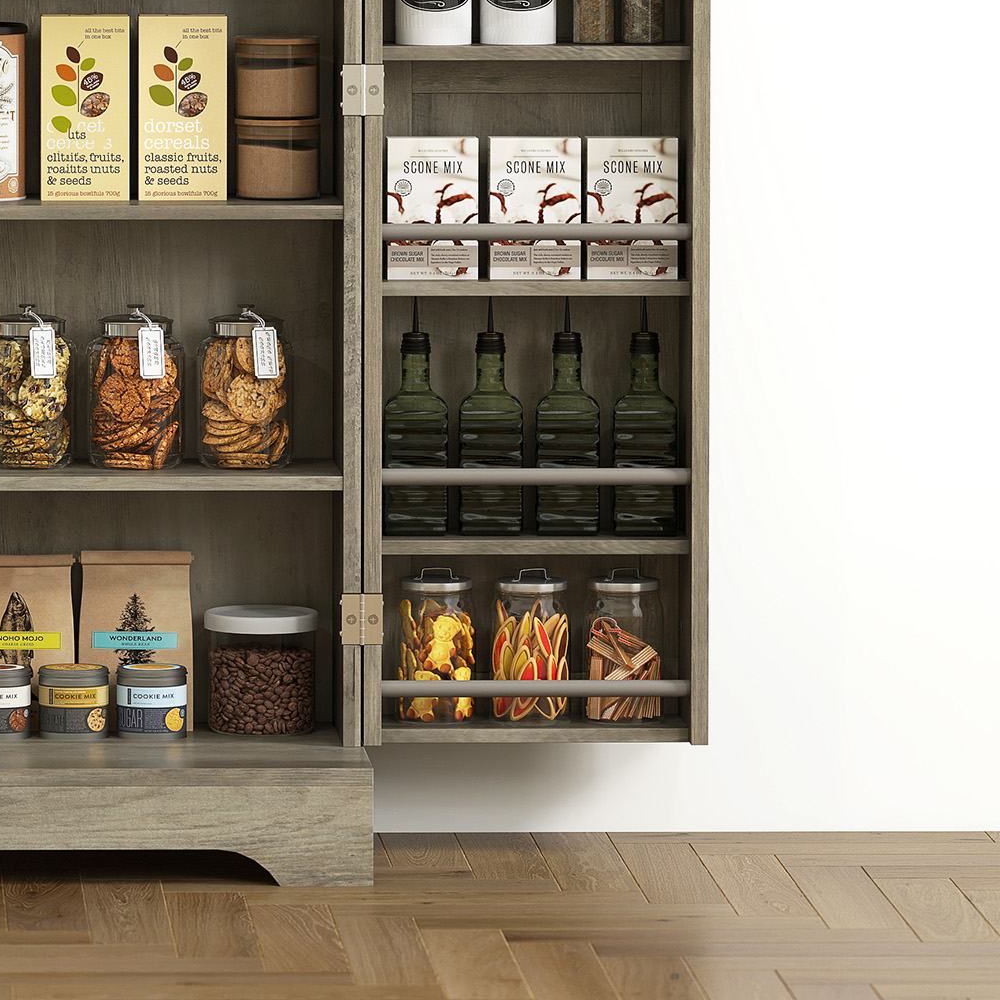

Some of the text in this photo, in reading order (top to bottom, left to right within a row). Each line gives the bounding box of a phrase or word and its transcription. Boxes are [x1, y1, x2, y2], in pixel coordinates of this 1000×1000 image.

[144, 118, 203, 133] dorset
[144, 135, 210, 150] cereals
[144, 152, 222, 164] classic fruits,
[144, 164, 218, 174] roasted nuts
[403, 160, 463, 174] SCONE MIX
[506, 160, 566, 174] SCONE MIX
[603, 160, 663, 174] SCONE MIX
[46, 175, 92, 186] & seeds
[144, 175, 190, 186] & seeds
